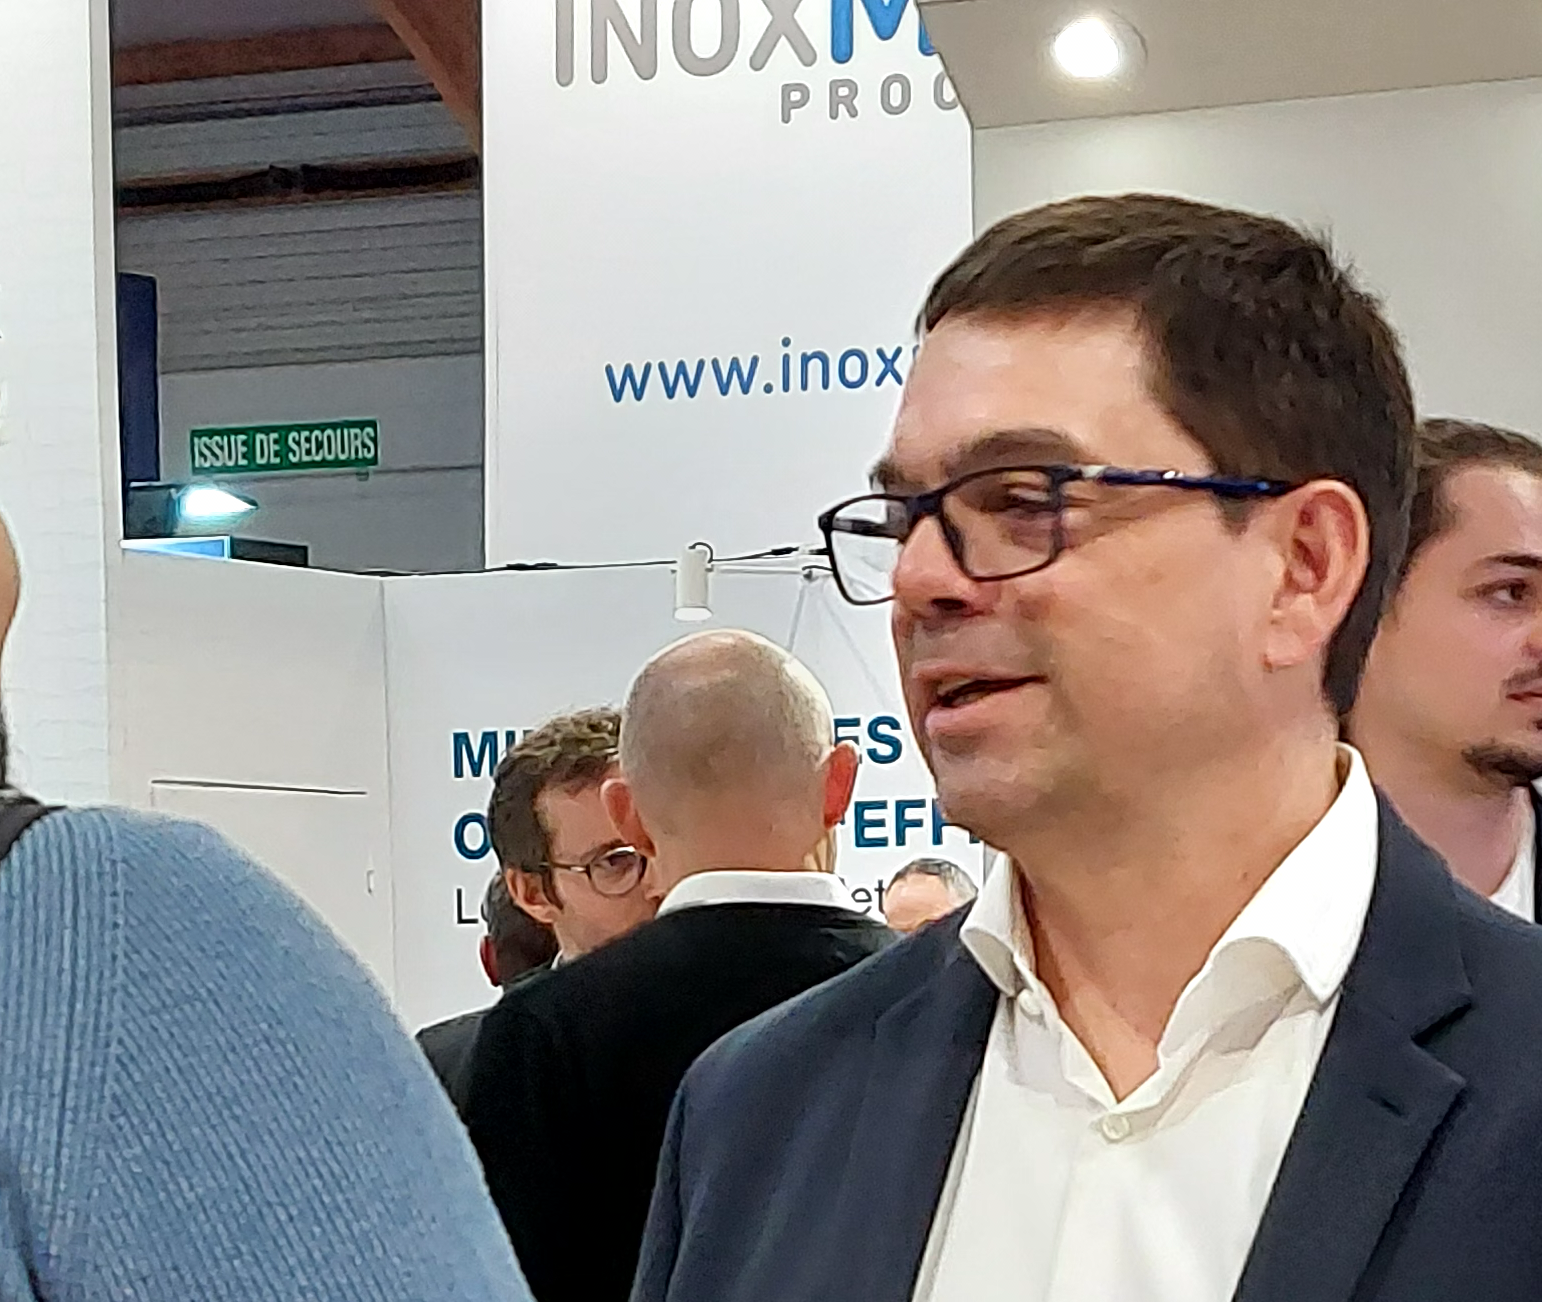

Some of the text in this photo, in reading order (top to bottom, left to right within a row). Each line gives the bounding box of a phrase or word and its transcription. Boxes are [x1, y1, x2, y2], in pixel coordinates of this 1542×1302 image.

[605, 336, 920, 403] www.inox
[193, 426, 376, 468] ISSUE DE SECOURS
